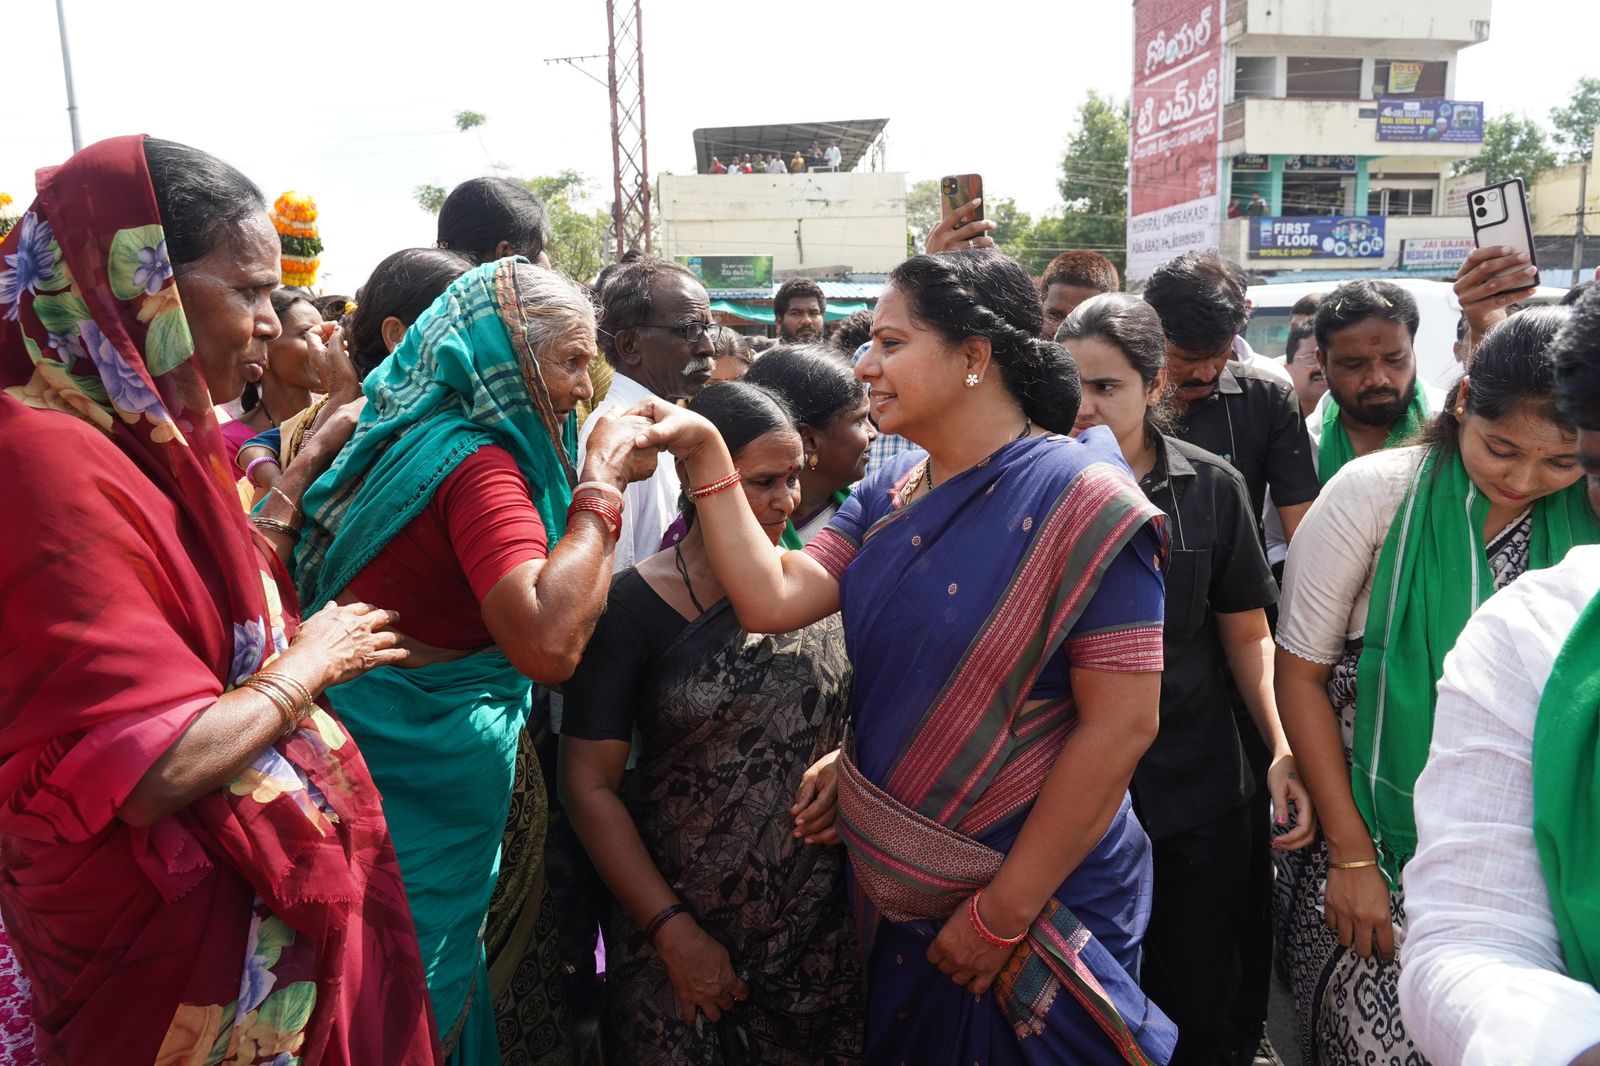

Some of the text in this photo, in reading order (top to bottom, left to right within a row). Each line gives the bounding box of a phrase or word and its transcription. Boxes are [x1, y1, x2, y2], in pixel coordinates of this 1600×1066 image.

[1144, 6, 1213, 76] గోయల్
[1274, 222, 1311, 235] FIRST
[1277, 234, 1318, 246] FLOOR
[1423, 240, 1437, 249] JAI
[1259, 248, 1313, 257] MOBILE SHOP
